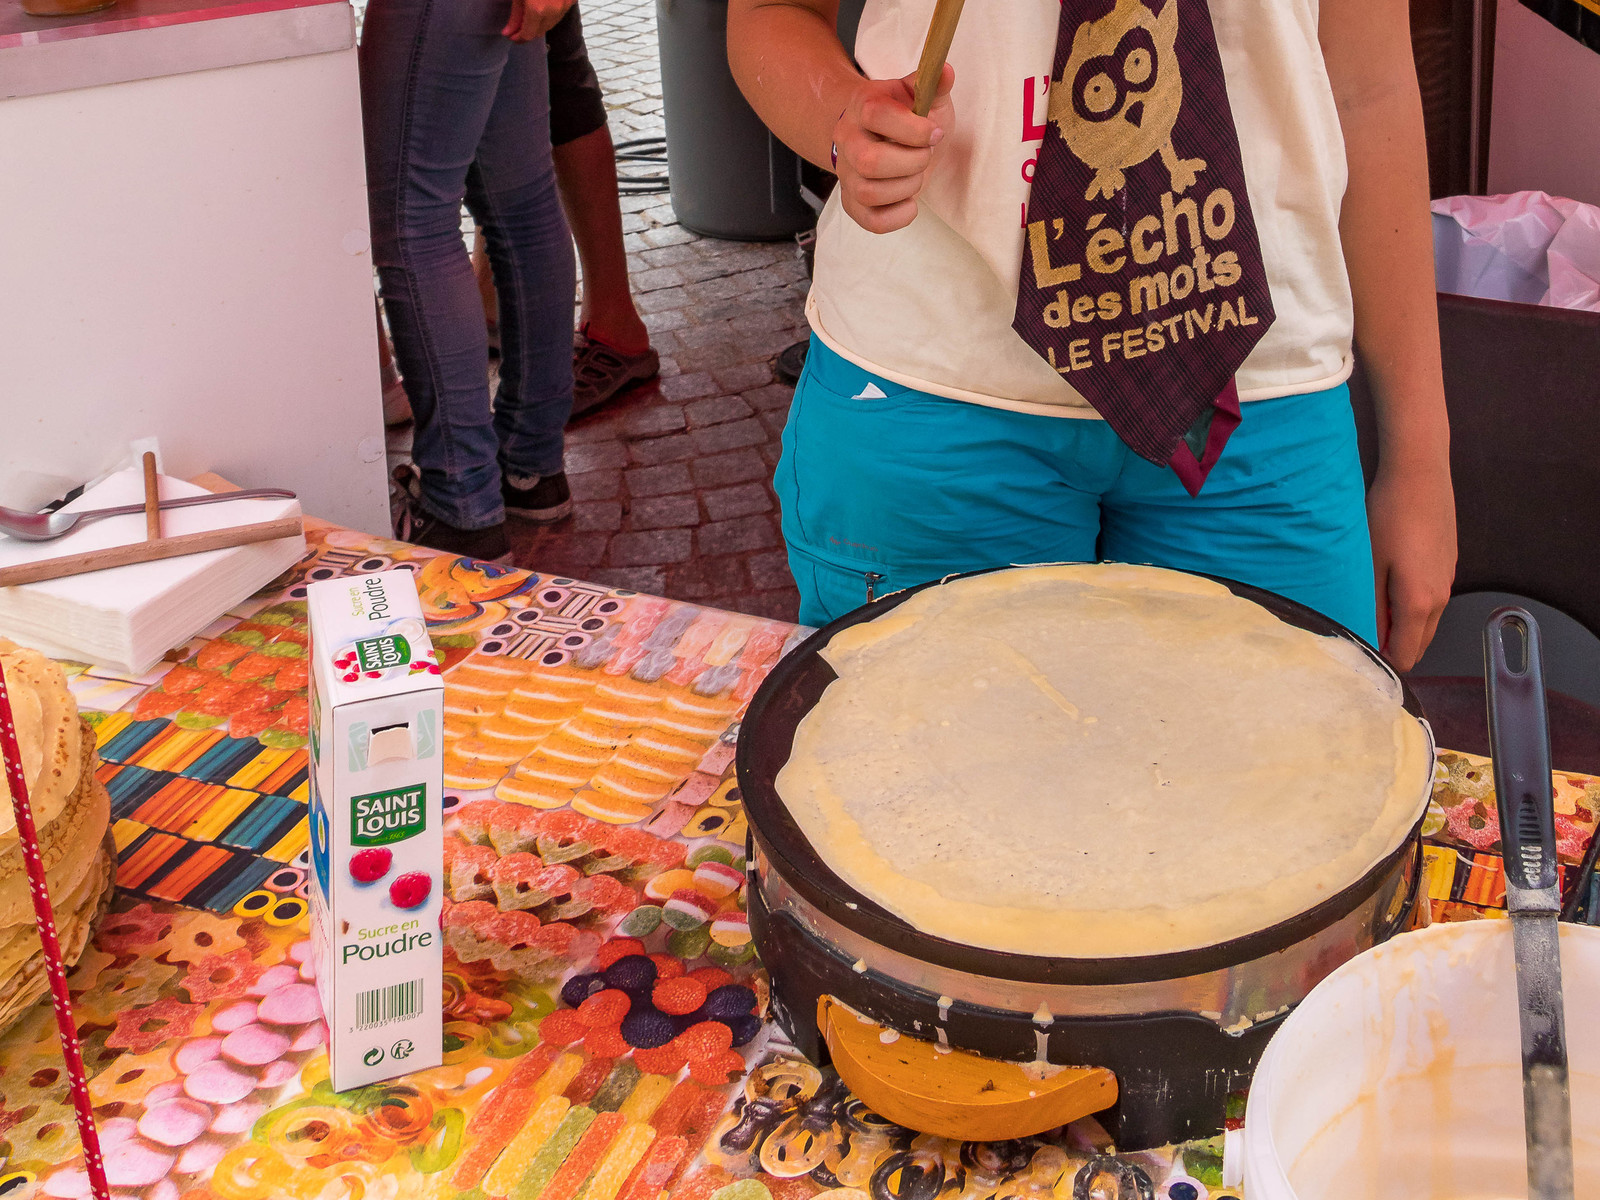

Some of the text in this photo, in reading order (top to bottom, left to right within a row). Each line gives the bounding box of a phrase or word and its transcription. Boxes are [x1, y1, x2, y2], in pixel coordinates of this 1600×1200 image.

[1028, 188, 1235, 289] L'écho
[1043, 245, 1242, 328] des mots
[1048, 296, 1258, 374] LE FESTIVAL
[362, 578, 390, 621] Poudre
[363, 641, 383, 669] SAINT
[379, 637, 401, 667] LOUIS
[356, 791, 421, 817] SAINT
[356, 808, 420, 837] LOUIS
[358, 919, 419, 941] Sucre en
[343, 932, 432, 965] Poudre
